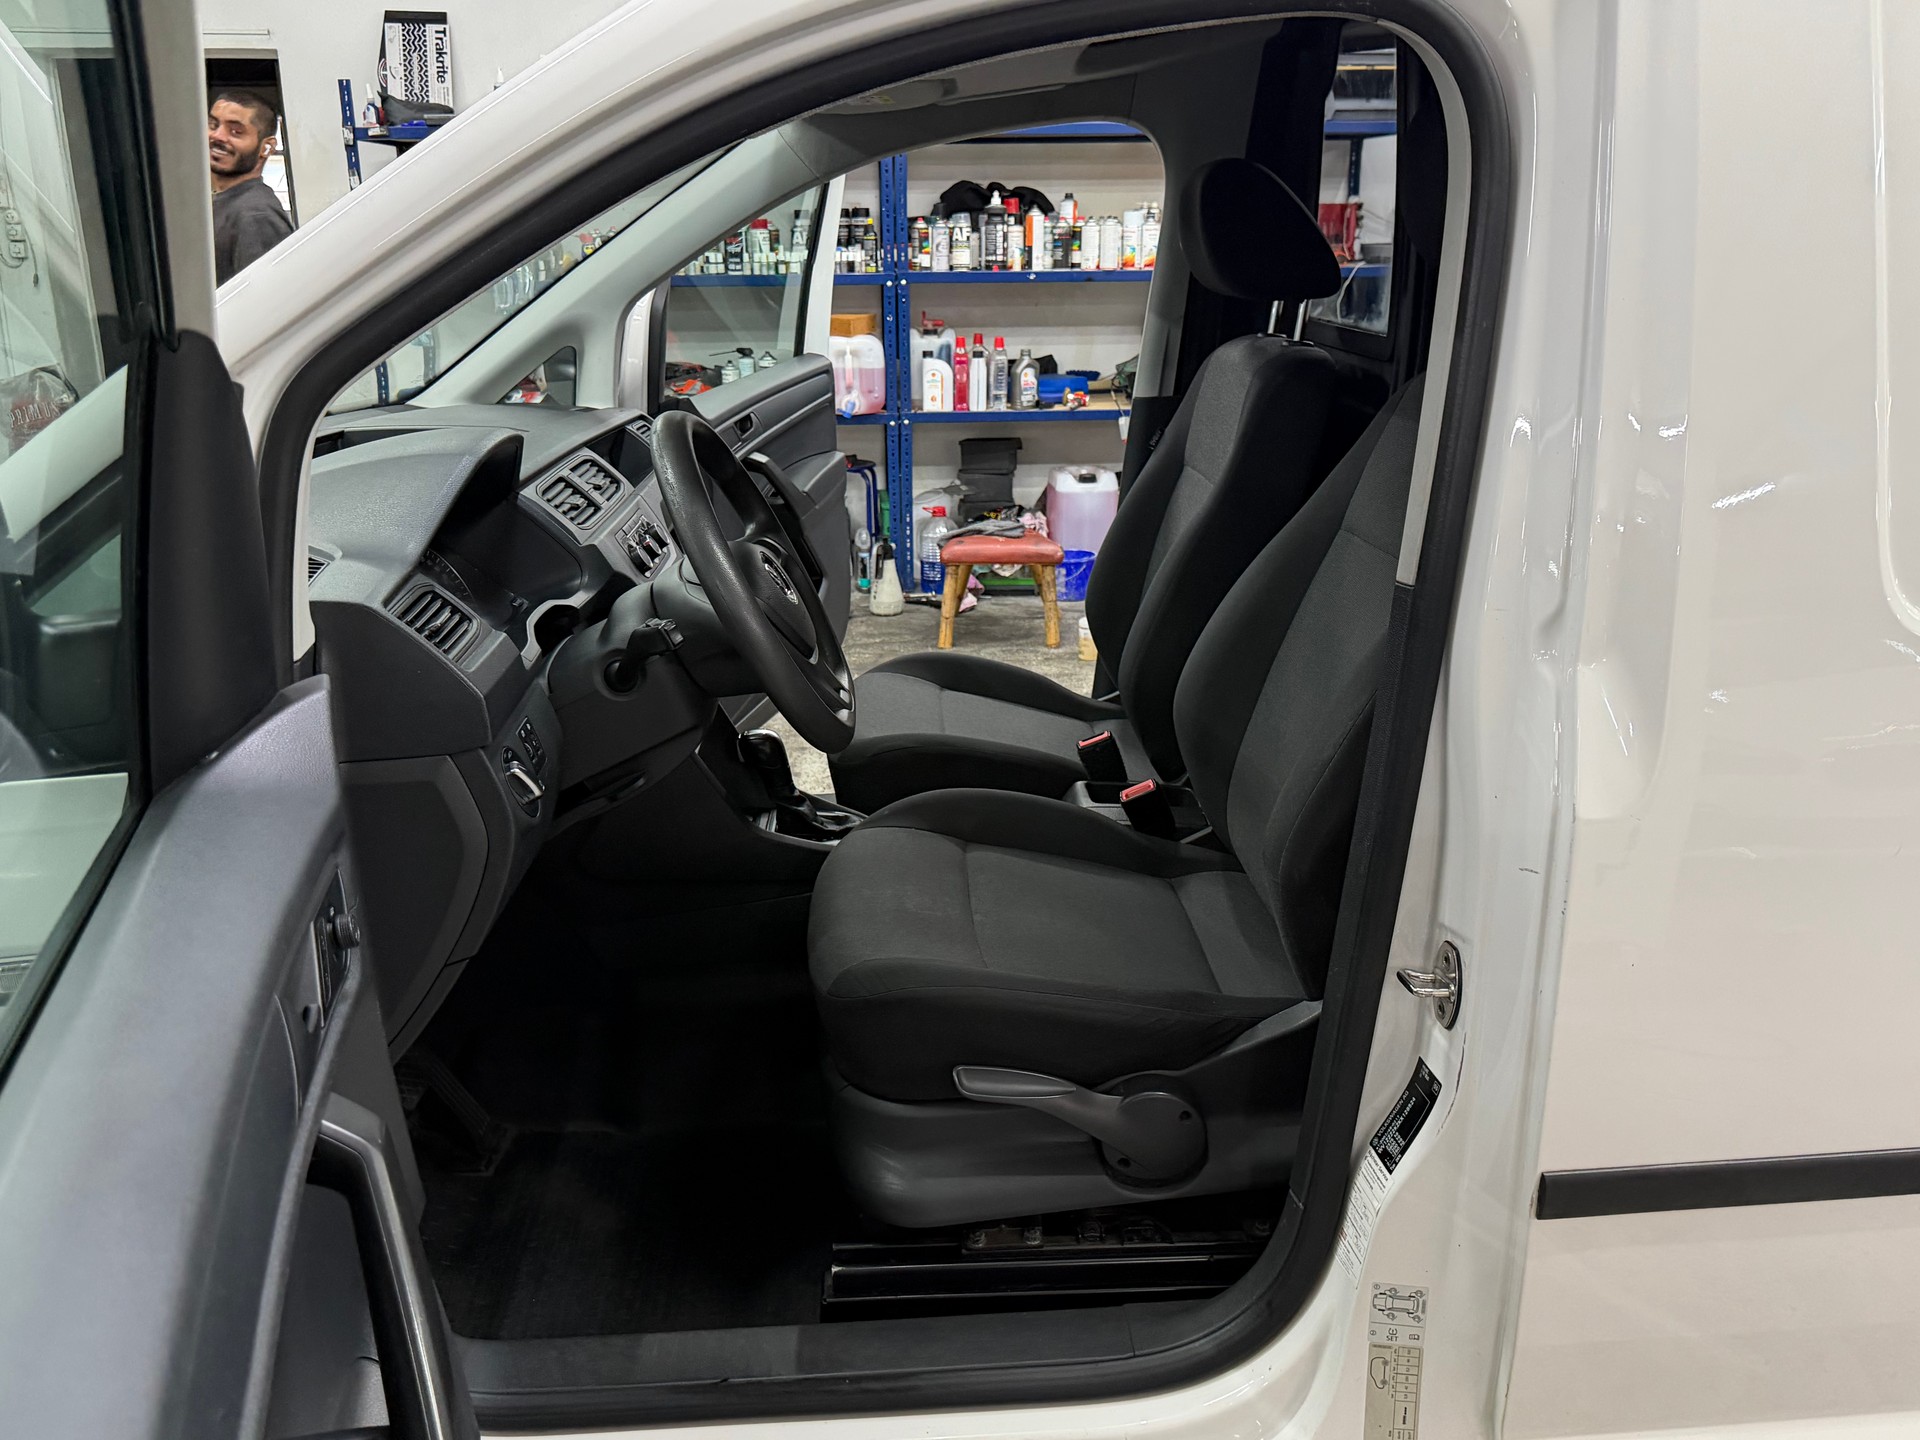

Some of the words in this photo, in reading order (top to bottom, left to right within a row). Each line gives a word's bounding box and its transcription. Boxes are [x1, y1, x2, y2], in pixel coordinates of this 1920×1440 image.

[434, 27, 449, 84] Trakrite
[953, 227, 971, 241] AF
[1377, 1098, 1403, 1136] VOLKSWAGEN
